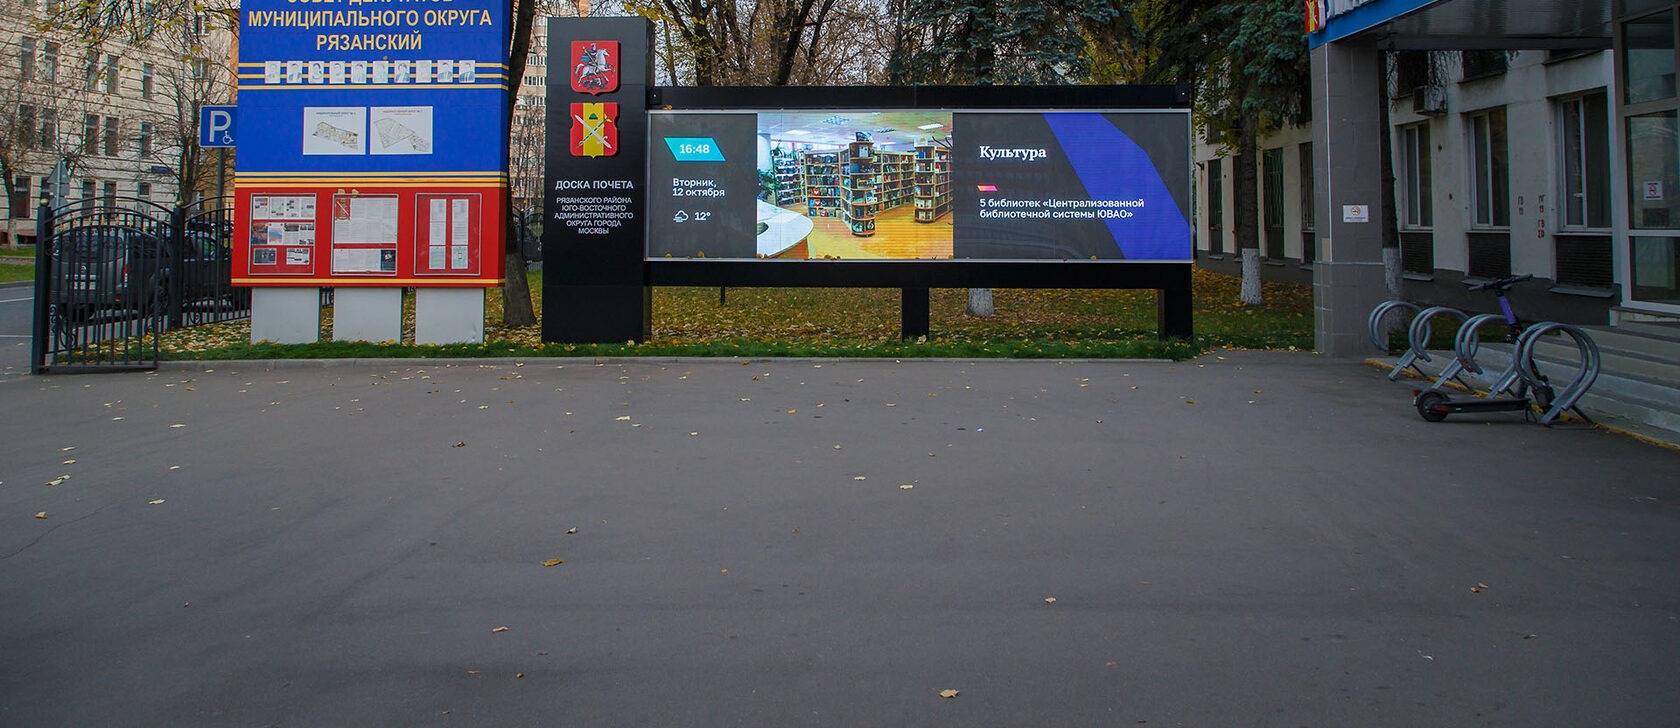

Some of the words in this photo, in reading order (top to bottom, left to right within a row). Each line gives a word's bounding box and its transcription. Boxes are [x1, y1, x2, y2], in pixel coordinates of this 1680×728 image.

[248, 10, 419, 29] МУНИЦИПАЛЬНОГО
[424, 9, 493, 26] ОКРУГА
[316, 30, 422, 51] РЯЗАНСКИЙ
[679, 144, 710, 154] 16:48
[979, 145, 1047, 161] Культура
[555, 180, 591, 191] ДОСКА
[593, 180, 634, 190] ПОЧЕТА
[672, 178, 717, 188] Вторник,
[672, 188, 684, 197] 12
[685, 187, 726, 198] октября
[603, 196, 633, 204] РАЙОНА
[979, 199, 986, 208] 5
[988, 198, 1041, 208] библиотек
[1042, 198, 1145, 209] «Централизованной
[561, 204, 627, 212] ЮГО-ВОСТОЧНОГО
[554, 212, 634, 220] АДМИНИСТРАТИВНОГО
[694, 211, 711, 221] 12°
[979, 208, 1050, 219] библиотечной
[1052, 209, 1095, 219] системы
[1097, 208, 1134, 219] ЮВАО»
[593, 220, 622, 228] ГОРОДА
[578, 227, 609, 235] МОСКВЫ
